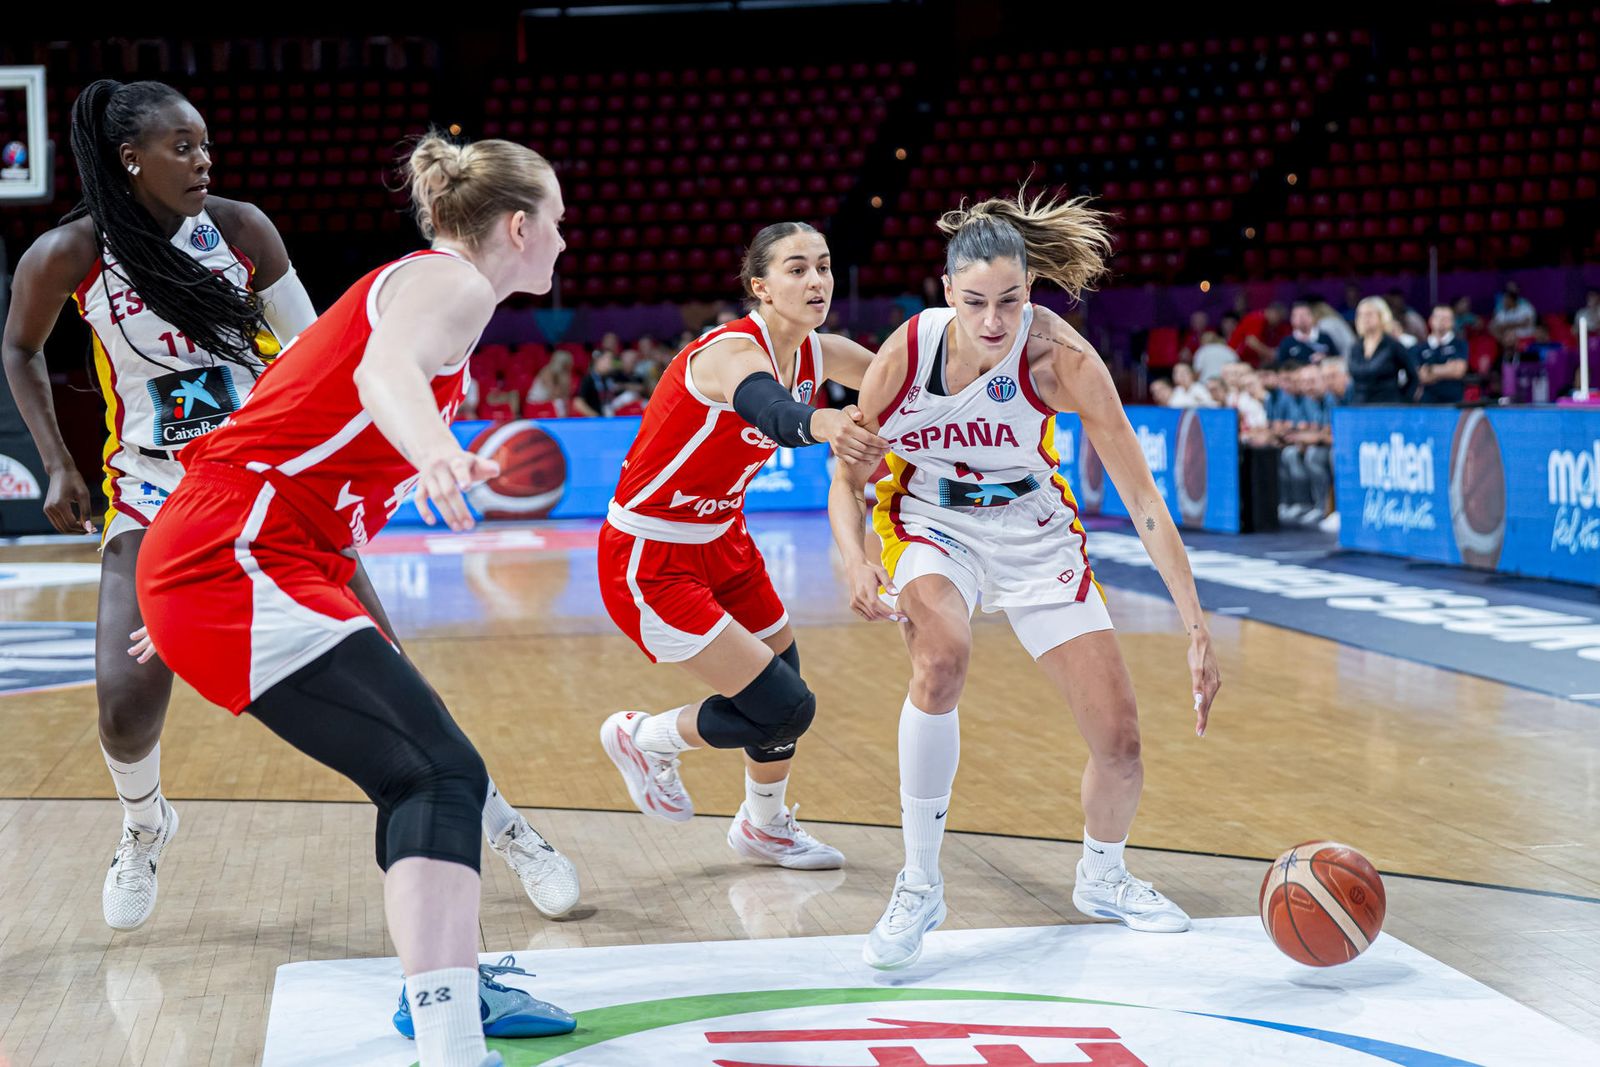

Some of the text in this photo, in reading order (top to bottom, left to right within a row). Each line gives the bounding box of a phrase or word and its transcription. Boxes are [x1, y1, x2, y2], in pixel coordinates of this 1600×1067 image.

[158, 330, 197, 357] 11
[163, 420, 222, 442] CaixaBa
[1359, 432, 1434, 494] molten
[416, 986, 452, 1007] 23
